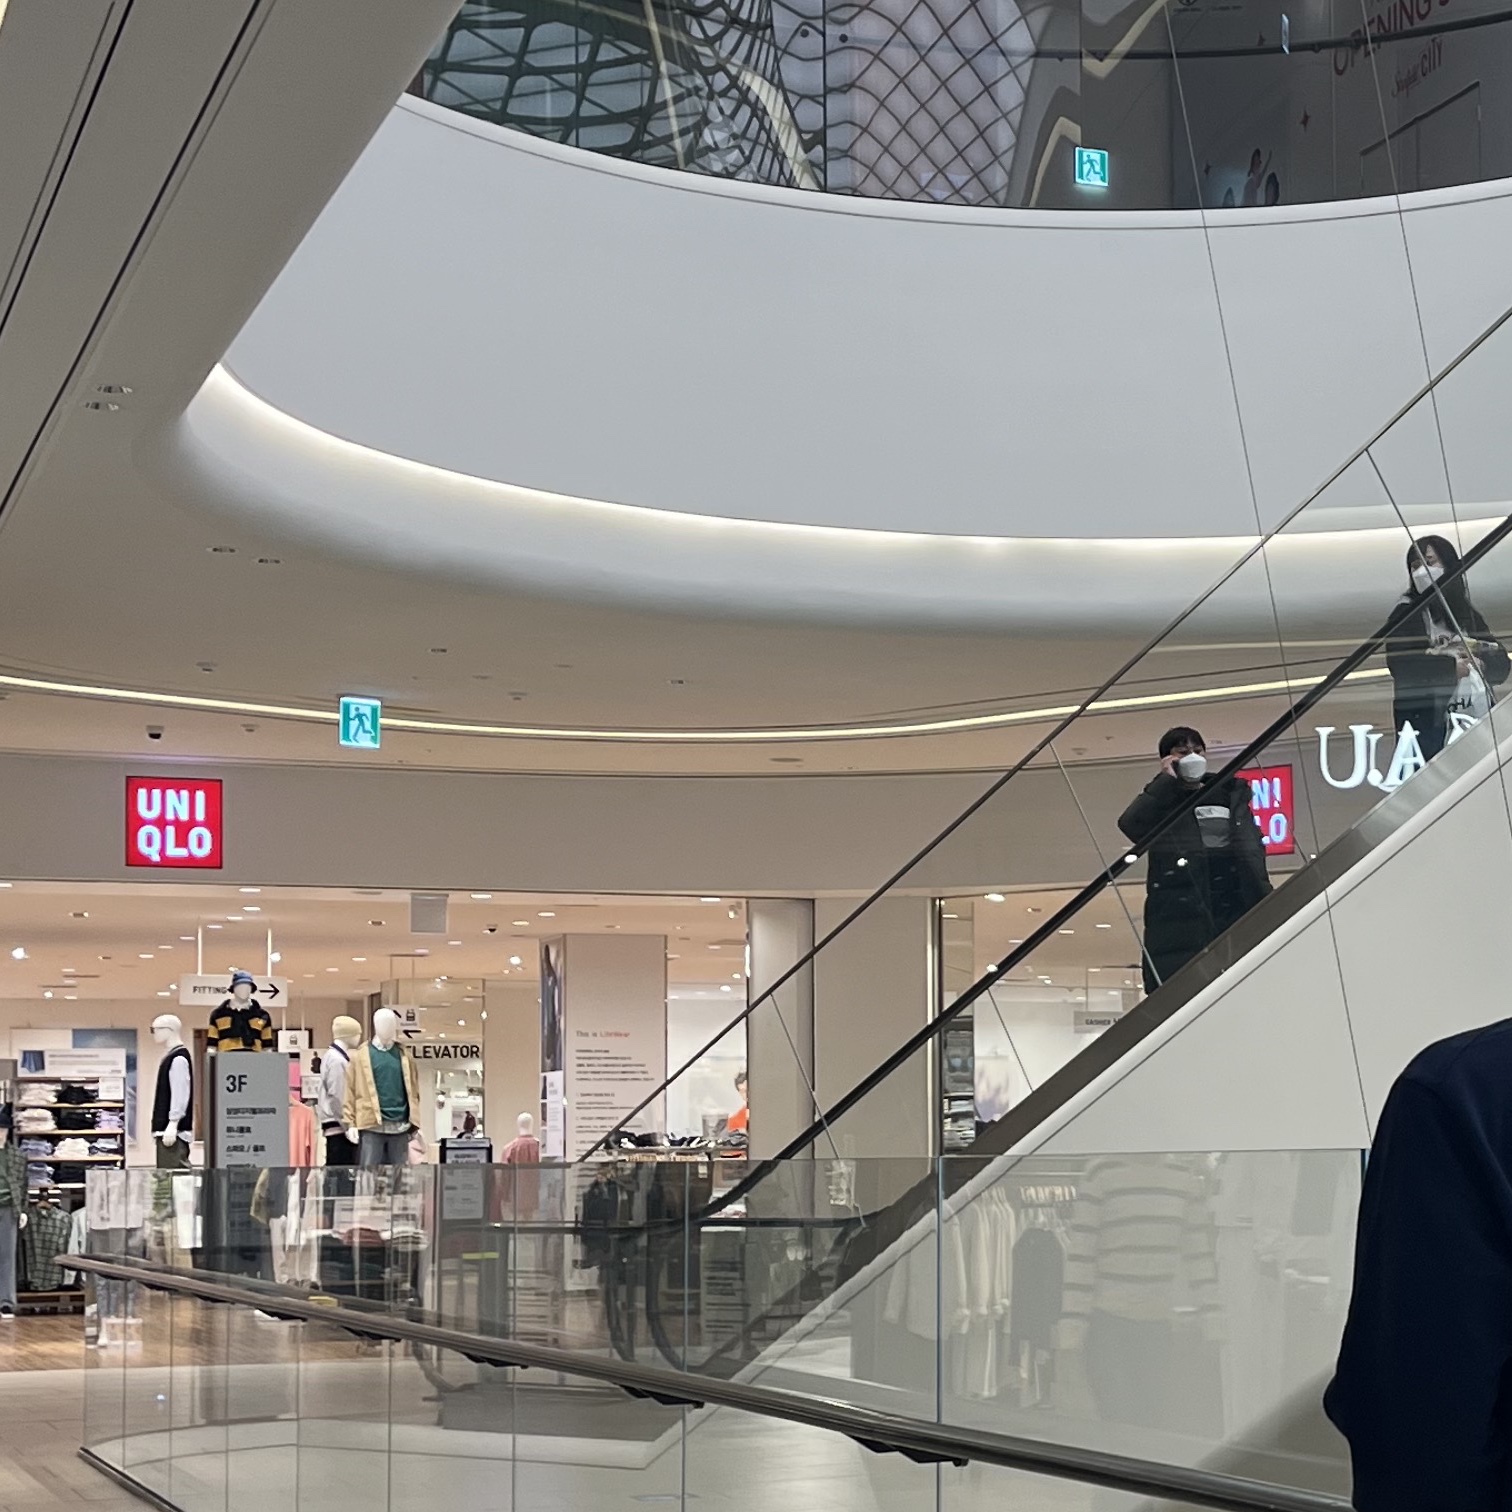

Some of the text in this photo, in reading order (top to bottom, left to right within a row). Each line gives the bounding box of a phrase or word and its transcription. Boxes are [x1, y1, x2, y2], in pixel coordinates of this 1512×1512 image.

[137, 787, 206, 822] UNI
[137, 825, 212, 862] QLO
[405, 1045, 480, 1059] LEVATOR
[226, 1074, 248, 1093] 3F
